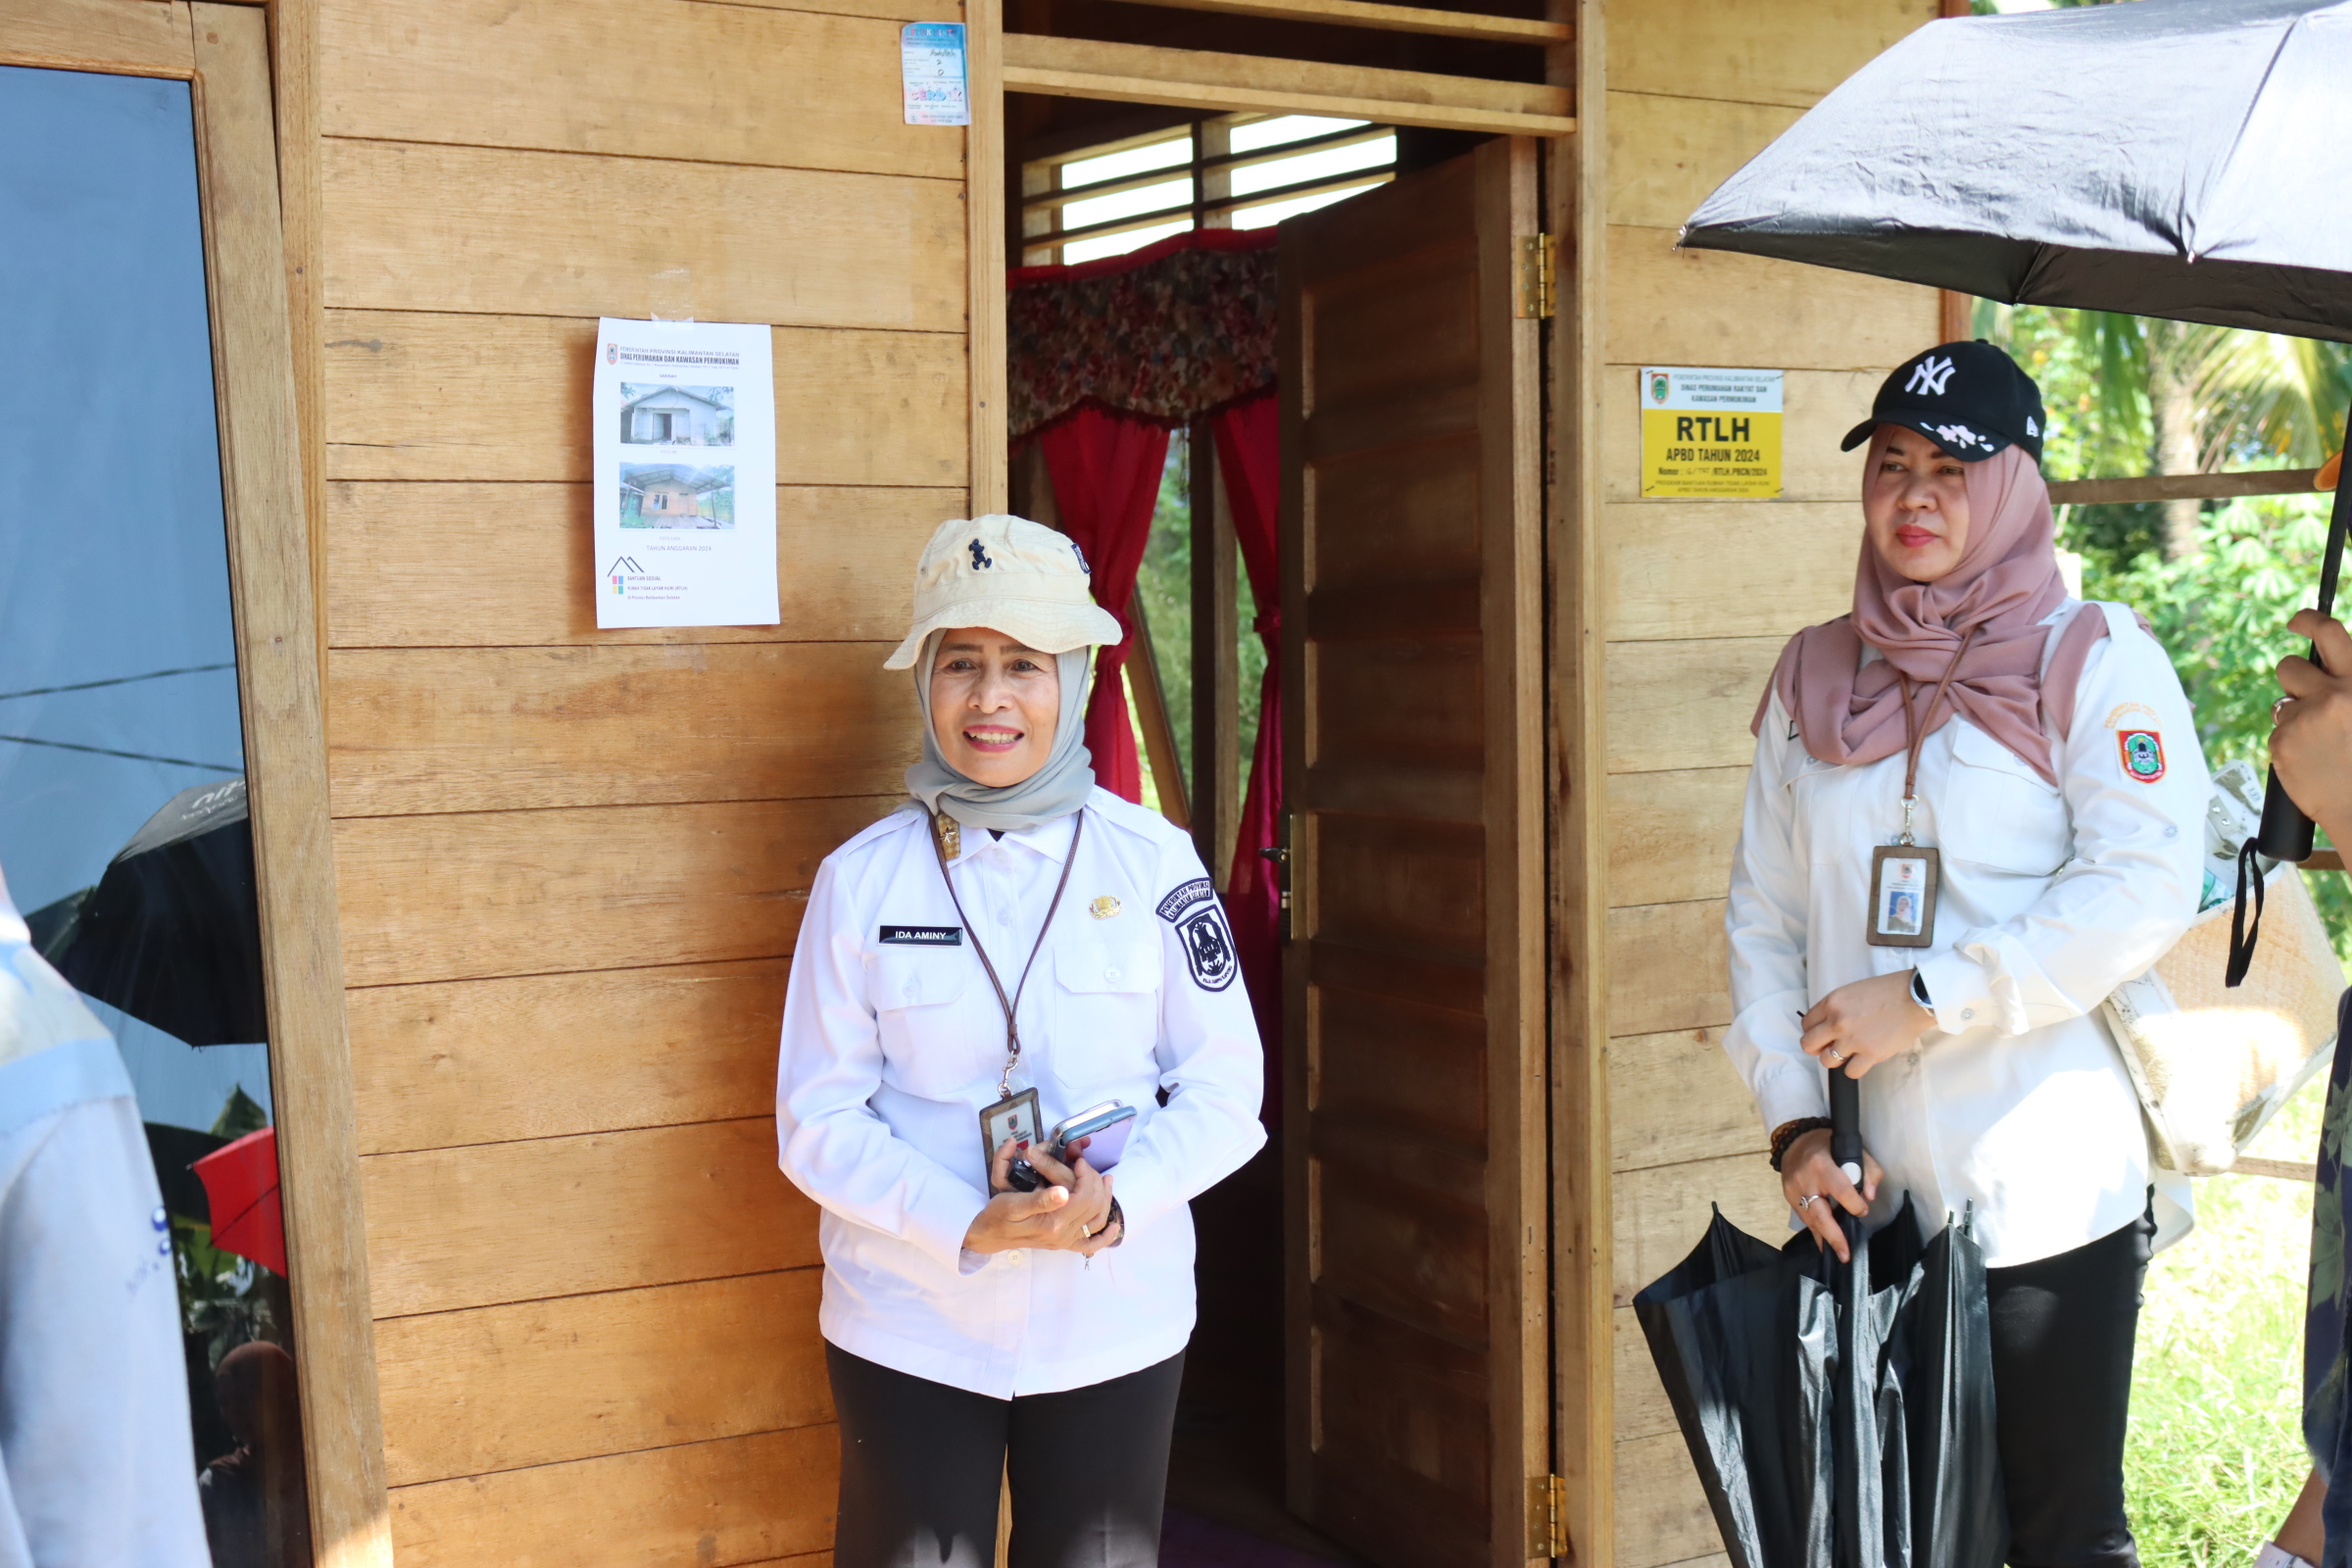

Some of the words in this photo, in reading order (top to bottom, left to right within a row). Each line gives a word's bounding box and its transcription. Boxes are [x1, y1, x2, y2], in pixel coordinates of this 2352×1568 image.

[633, 353, 662, 363] PERUMAHAN
[676, 356, 704, 365] KAWASAN
[704, 357, 739, 366] PERMUKIMAN
[1904, 356, 1956, 396] NY
[1677, 416, 1749, 442] RTLH
[1666, 448, 1693, 462] APBD
[1698, 448, 1731, 462] TAHUN
[1735, 449, 1760, 463] 2024
[1159, 886, 1188, 915] PEMERINTAH
[1187, 881, 1210, 893] PROVINSI
[914, 931, 947, 940] AMINY
